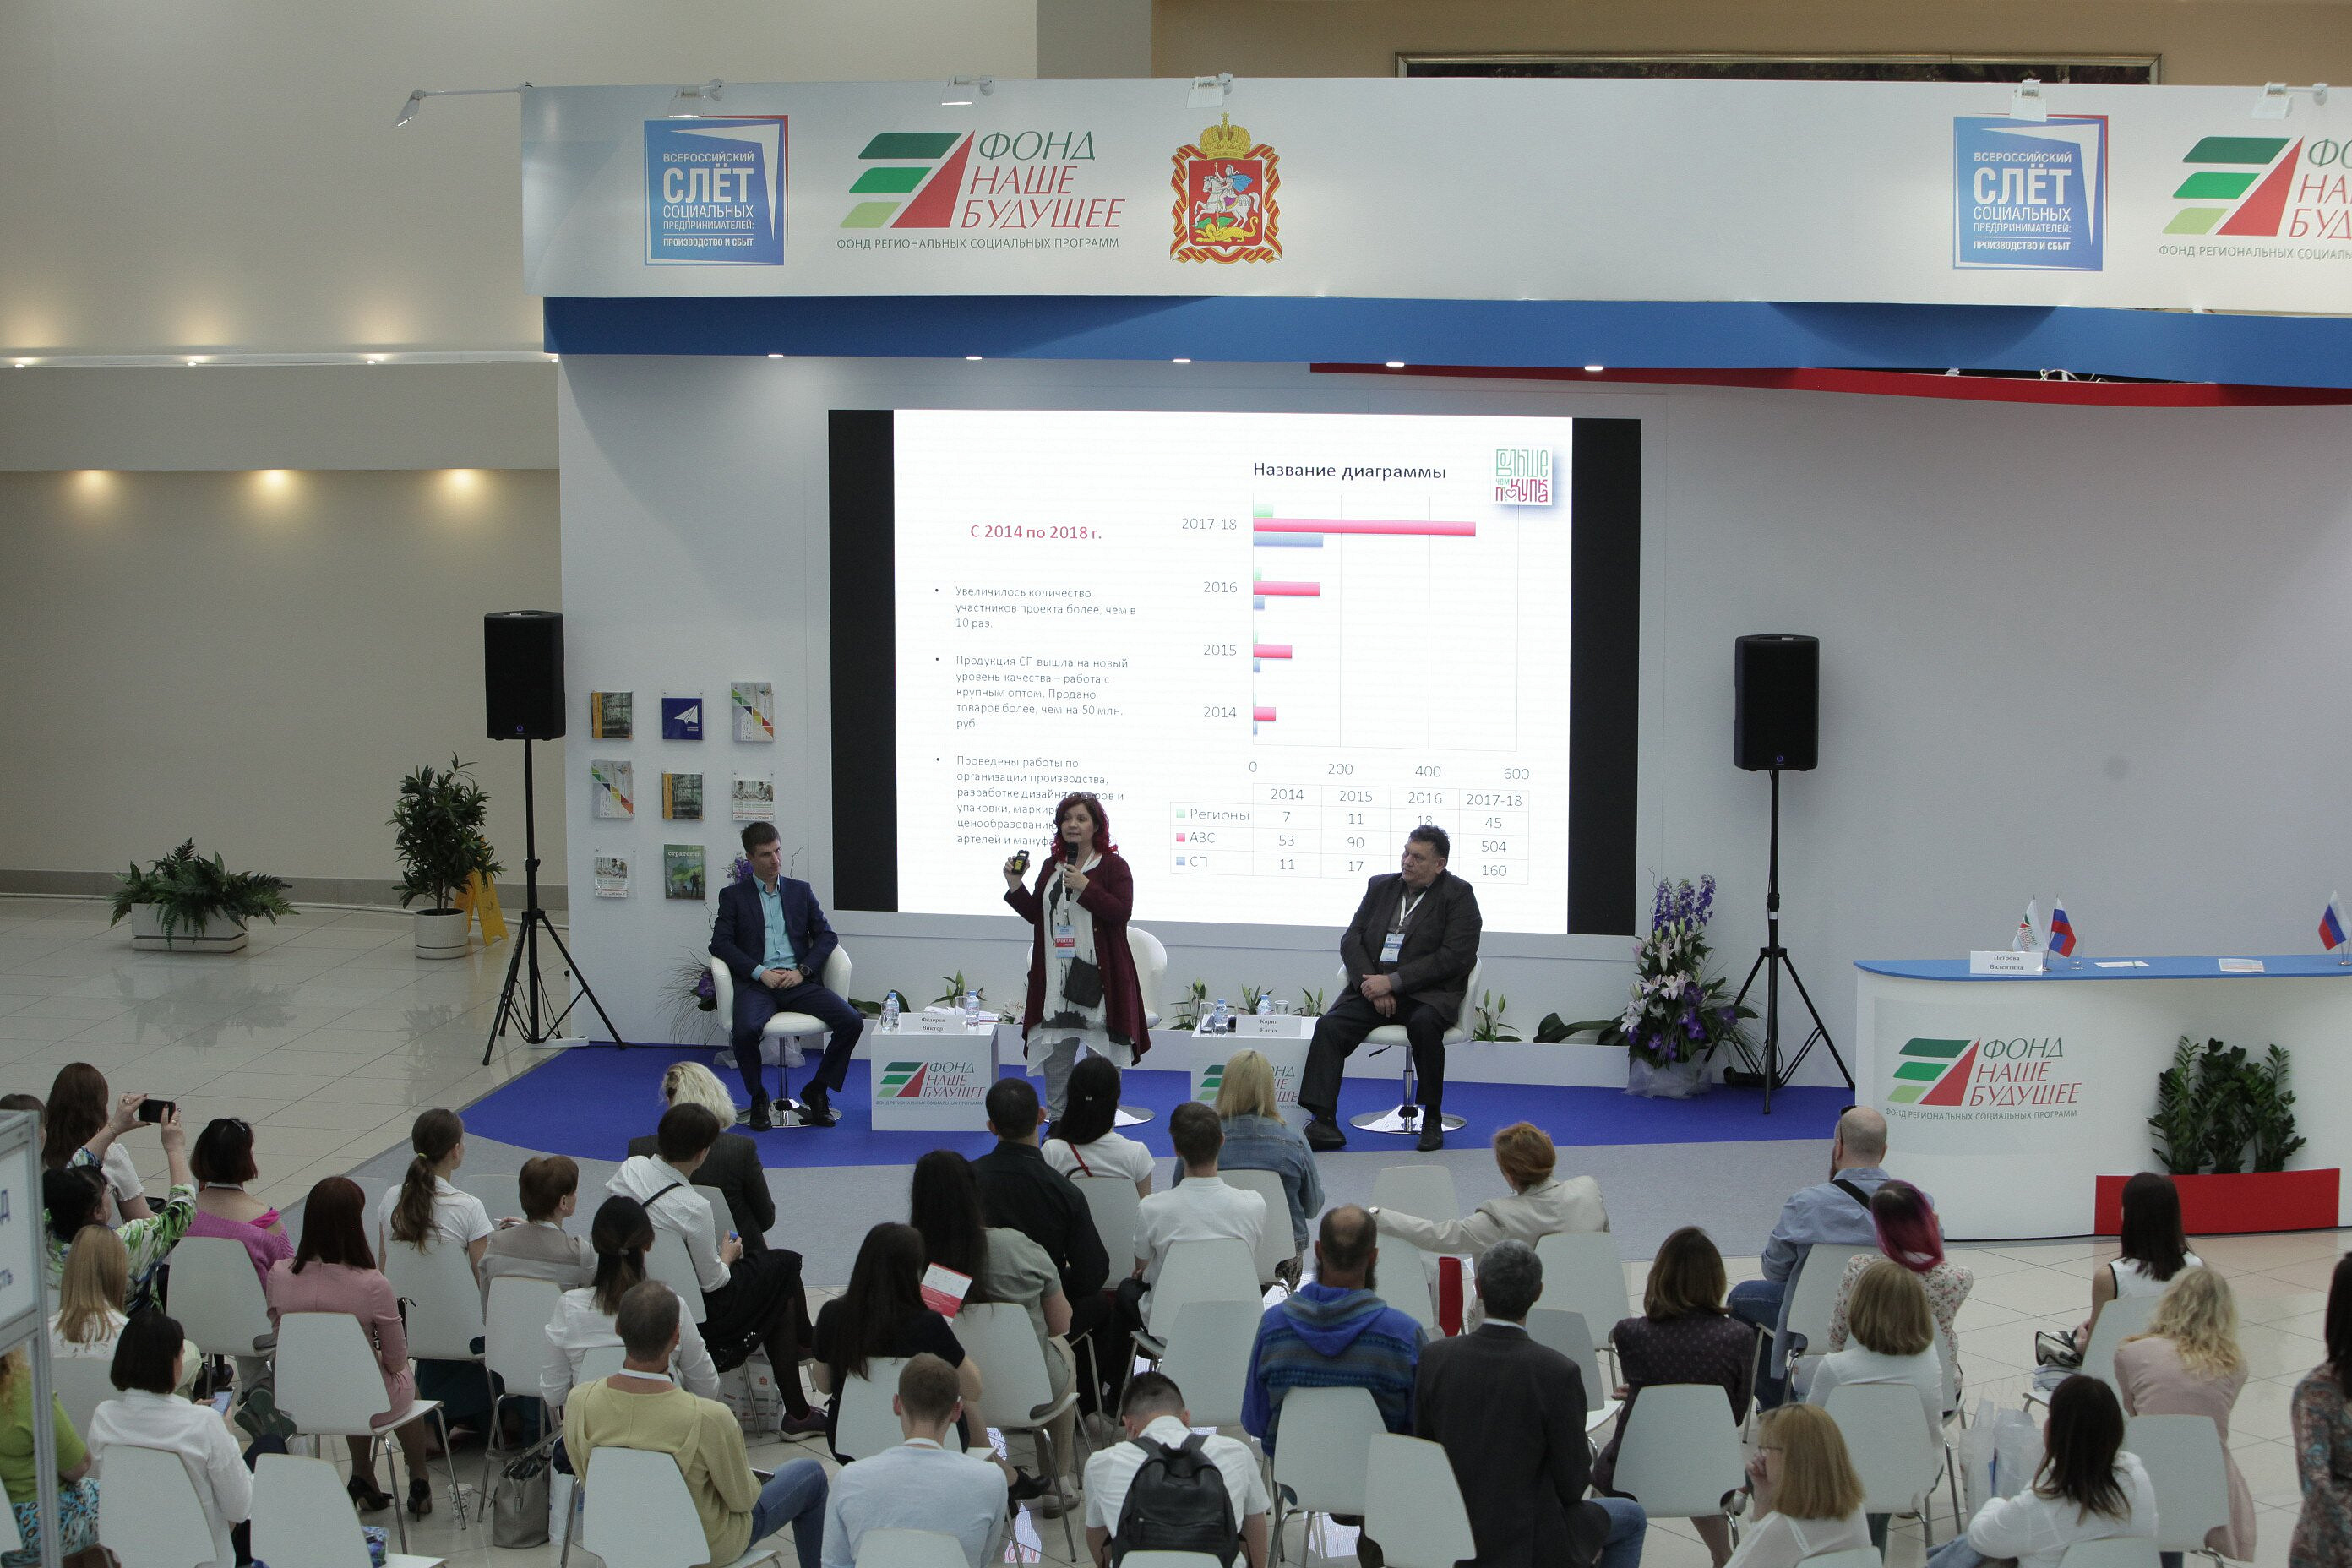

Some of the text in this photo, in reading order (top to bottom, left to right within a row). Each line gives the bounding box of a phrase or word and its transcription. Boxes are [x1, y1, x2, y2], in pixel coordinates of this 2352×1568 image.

[978, 131, 1096, 161] ФОНД
[663, 150, 754, 162] ВСЕРОССИЙСКИЙ
[1974, 150, 2072, 162] ВСЕРОССИЙСКИЙ
[663, 163, 754, 203] СЛЁТ
[969, 166, 1078, 194] НАШЕ
[1974, 163, 2072, 205] СЛЁТ
[2298, 173, 2352, 204] НА
[663, 205, 754, 220] СОЦИАЛЬНЫХ
[961, 199, 1126, 229] БУДУЩЕЕ
[1974, 206, 2071, 221] СОЦИАЛЬНЫХ
[663, 220, 754, 231] ПРЕДПРИНИМАТЕЛЕЙ:
[1974, 222, 2072, 234] ПРЕДПРИНИМАТЕЛЕЙ:
[663, 238, 754, 248] ПРОИЗВОДСТВО И СБЫТ
[836, 238, 1119, 250] ФОНД РЕГИОНАЛЬНЫХ СОЦИАЛЬНЫХ ПРОГРАММ
[1974, 241, 2071, 251] ПРОИЗВОДСТВО И СБЫТ
[2159, 245, 2195, 258] ФОНД
[2199, 245, 2294, 259] РЕГИОНАЛЬНЫХ
[1255, 463, 1446, 481] Название диаграммы
[1183, 518, 1236, 530] 2017-18
[971, 525, 1101, 539] С 2014 по 2018 г.
[956, 586, 1026, 596] Увеличилось
[1204, 581, 1237, 592] 2016
[956, 605, 1016, 613] участников
[1021, 606, 1063, 614] проекта
[1067, 604, 1102, 615] более,
[956, 618, 992, 629] 10 раз.
[1204, 645, 1236, 656] 2015
[957, 656, 1015, 667] Продукция
[1020, 656, 1032, 666] СП
[1094, 659, 1127, 667] новый
[956, 674, 999, 683] уровень
[1064, 673, 1100, 684] работа
[957, 689, 1004, 699] крупным
[1049, 689, 1096, 700] Продано
[957, 705, 999, 714] товаров
[1003, 703, 1037, 714] более,
[1083, 705, 1094, 714] 50
[1204, 706, 1236, 717] 2014
[957, 718, 977, 729] руб.
[958, 756, 1018, 767] Проведены
[1023, 757, 1062, 768] работы
[1250, 762, 1257, 772] 0
[1329, 764, 1353, 775] 200
[1415, 766, 1440, 777] 400
[1505, 769, 1529, 779] 600
[957, 774, 1108, 785] организации производства,
[958, 787, 1019, 798] разработке
[1271, 789, 1522, 806] 2014 2015 2016 2017-18
[957, 805, 1057, 816] упаковки, маркир
[1191, 808, 1249, 820] Регионы
[1283, 811, 1290, 822] 7
[1349, 814, 1363, 825] 11
[1484, 817, 1502, 829] 45
[957, 835, 1001, 845] артелей
[1014, 836, 1054, 847] мануфа
[1190, 832, 1506, 852] АЗС 53 90 504
[1190, 856, 1506, 876] СП 11 17 160
[1983, 1037, 2064, 1059] ФОНД
[929, 1061, 974, 1073] ФОНД
[1976, 1061, 2051, 1083] НАШЕ
[926, 1074, 968, 1086] НАШЕ
[923, 1086, 986, 1098] БУДУЩЕЕ
[1968, 1082, 2082, 1107] БУДУЩЕЕ
[1885, 1108, 2077, 1121] ФОНД РЕГИОНАЛЬНЫХ СОЦИАЛЬНЫХ ПРОГРАММ
